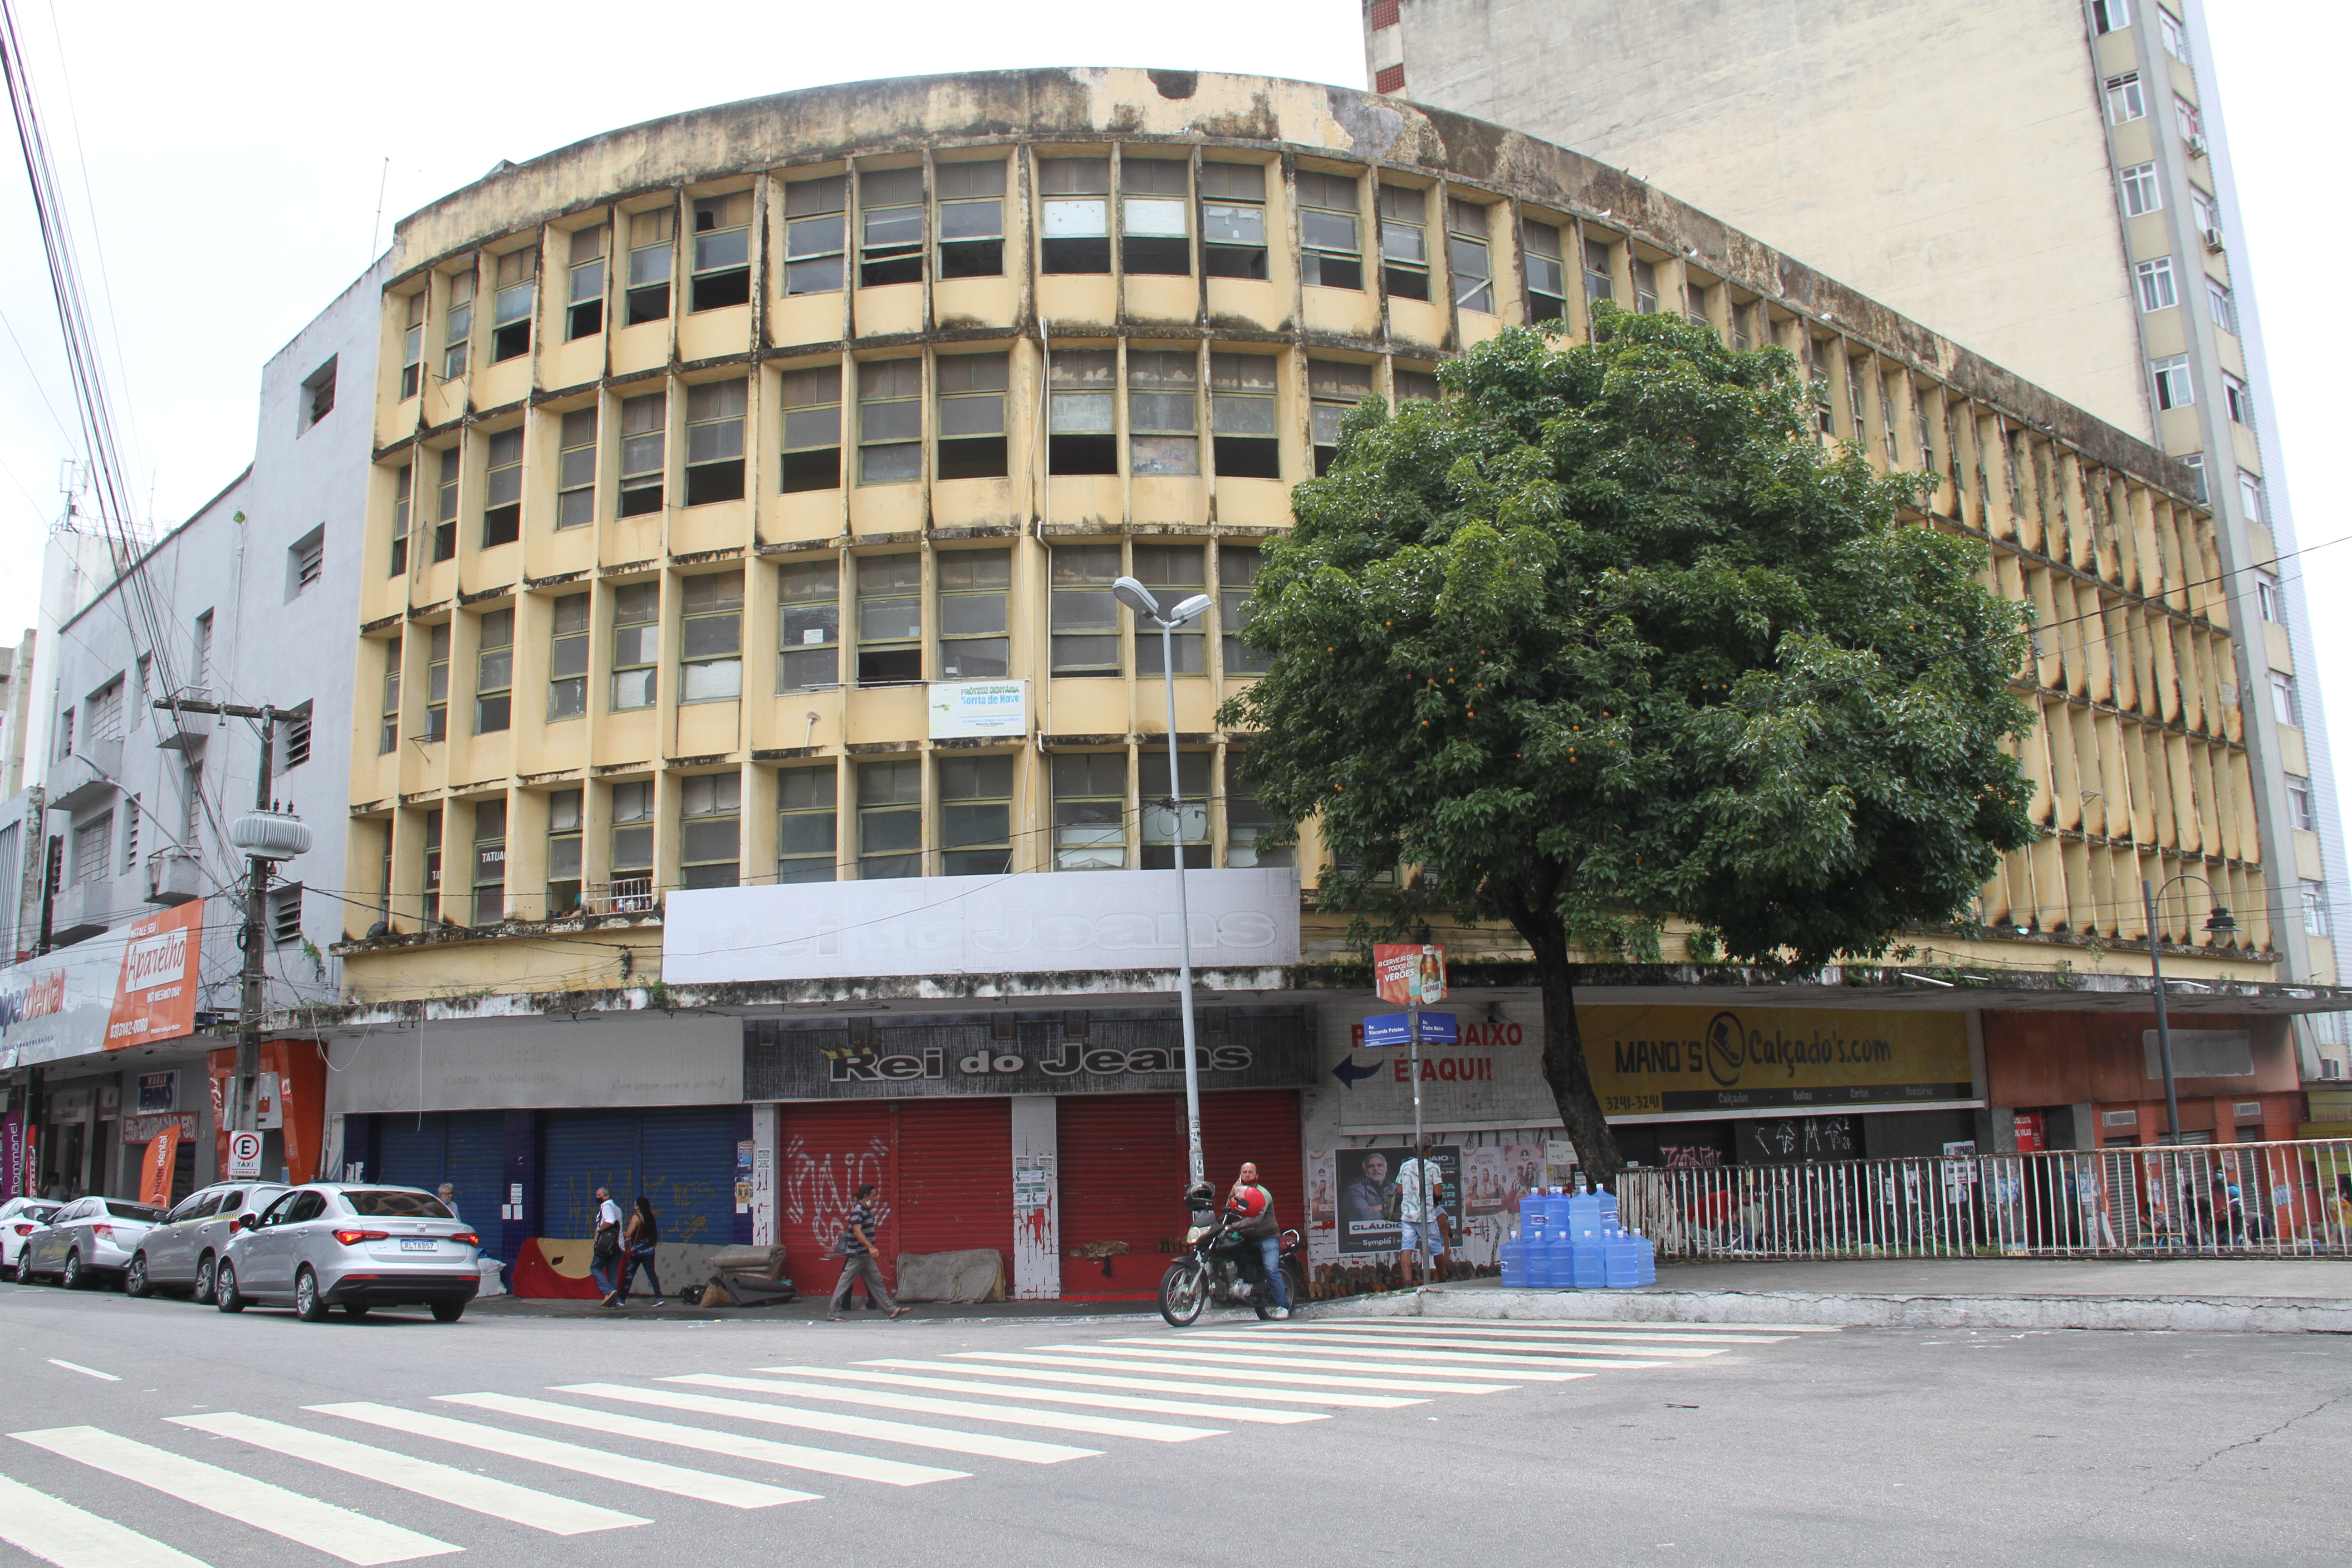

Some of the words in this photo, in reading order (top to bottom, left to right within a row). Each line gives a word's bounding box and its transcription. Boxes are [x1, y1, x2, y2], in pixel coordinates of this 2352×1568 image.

[960, 686, 989, 695] PRÓTESE
[990, 685, 1019, 694] DENTÁRIA
[961, 696, 986, 705] Sorria
[988, 695, 998, 704] de
[1000, 695, 1020, 703] Novo
[148, 922, 157, 934] SEU
[127, 934, 186, 988] Aparelho
[1383, 956, 1406, 966] CERVEJA
[1388, 963, 1406, 972] TODOS
[1384, 968, 1416, 983] VERÕES.
[147, 992, 154, 1004] NO
[154, 988, 171, 1001] MESMO
[1422, 984, 1439, 994] ITAIPAVA
[830, 1047, 943, 1082] Rei
[960, 1050, 1024, 1073] do
[1039, 1043, 1253, 1075] Jeans
[1394, 1053, 1410, 1083] É
[1420, 1058, 1492, 1082] AQUI!
[148, 1074, 167, 1085] WORLD
[1605, 1094, 1659, 1110] 3241-3241
[1718, 1092, 1749, 1107] Calçados
[1793, 1090, 1812, 1100] Bolsas
[241, 1140, 251, 1155] E
[9, 1122, 21, 1195] Rommanel
